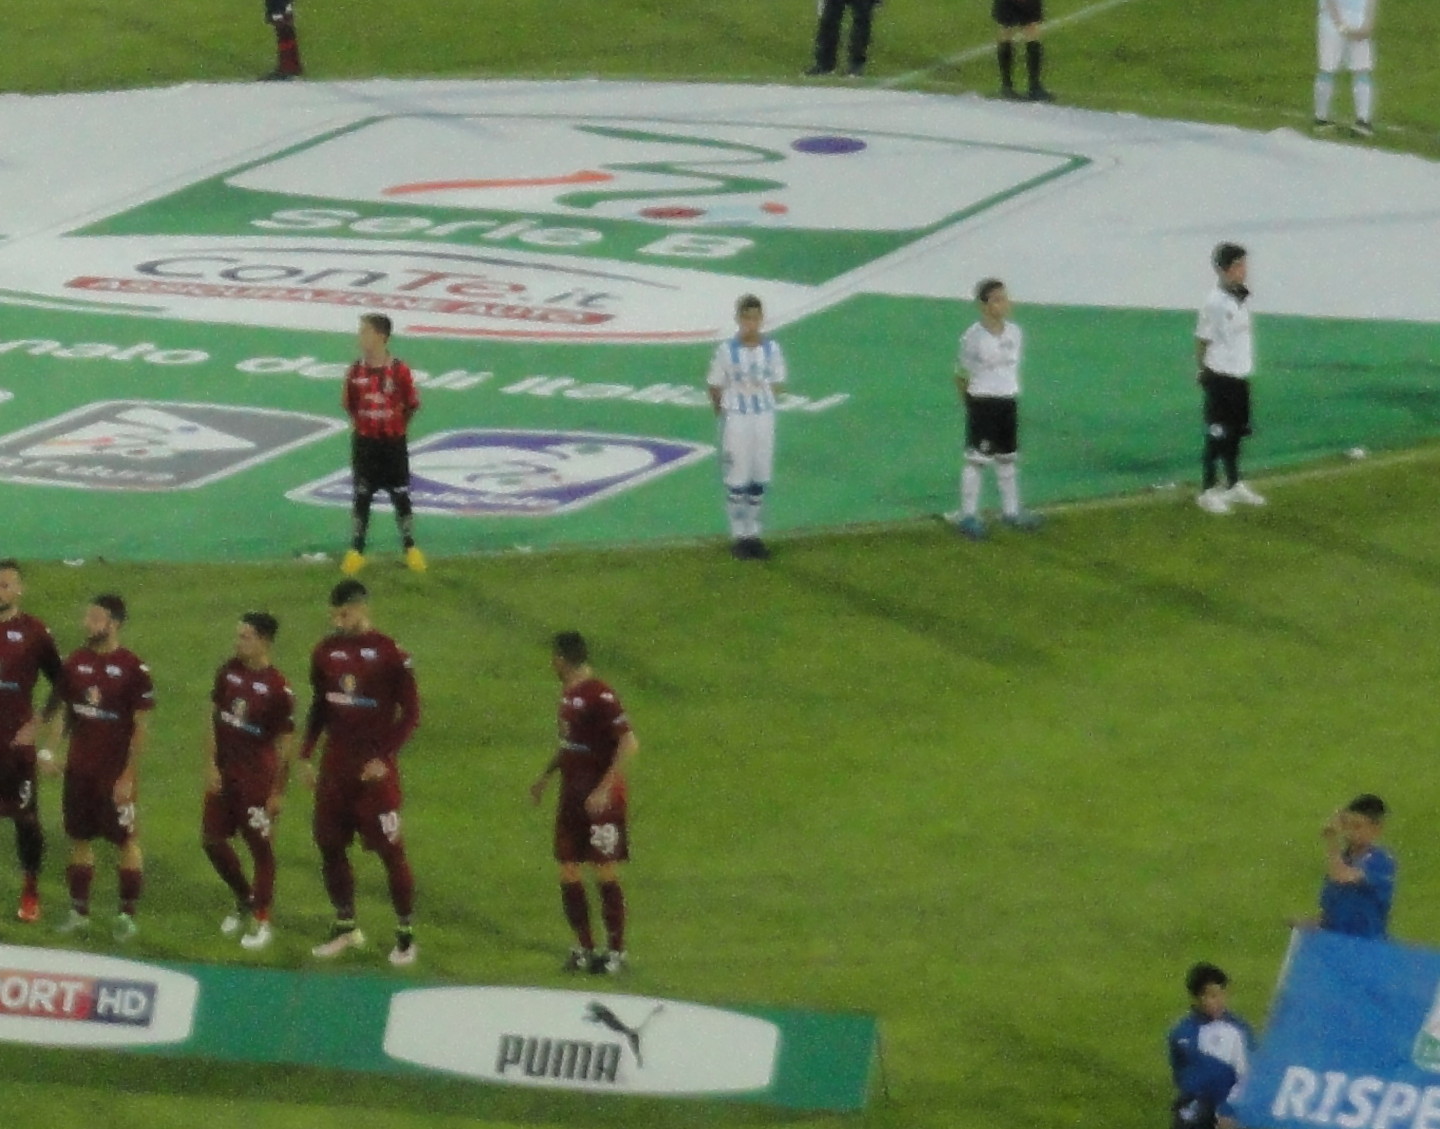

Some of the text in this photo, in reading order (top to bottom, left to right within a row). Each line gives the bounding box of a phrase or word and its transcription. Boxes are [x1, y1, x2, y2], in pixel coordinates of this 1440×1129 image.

[249, 207, 755, 258] Serie B
[96, 986, 148, 1016] HD
[496, 1033, 622, 1083] PUMA
